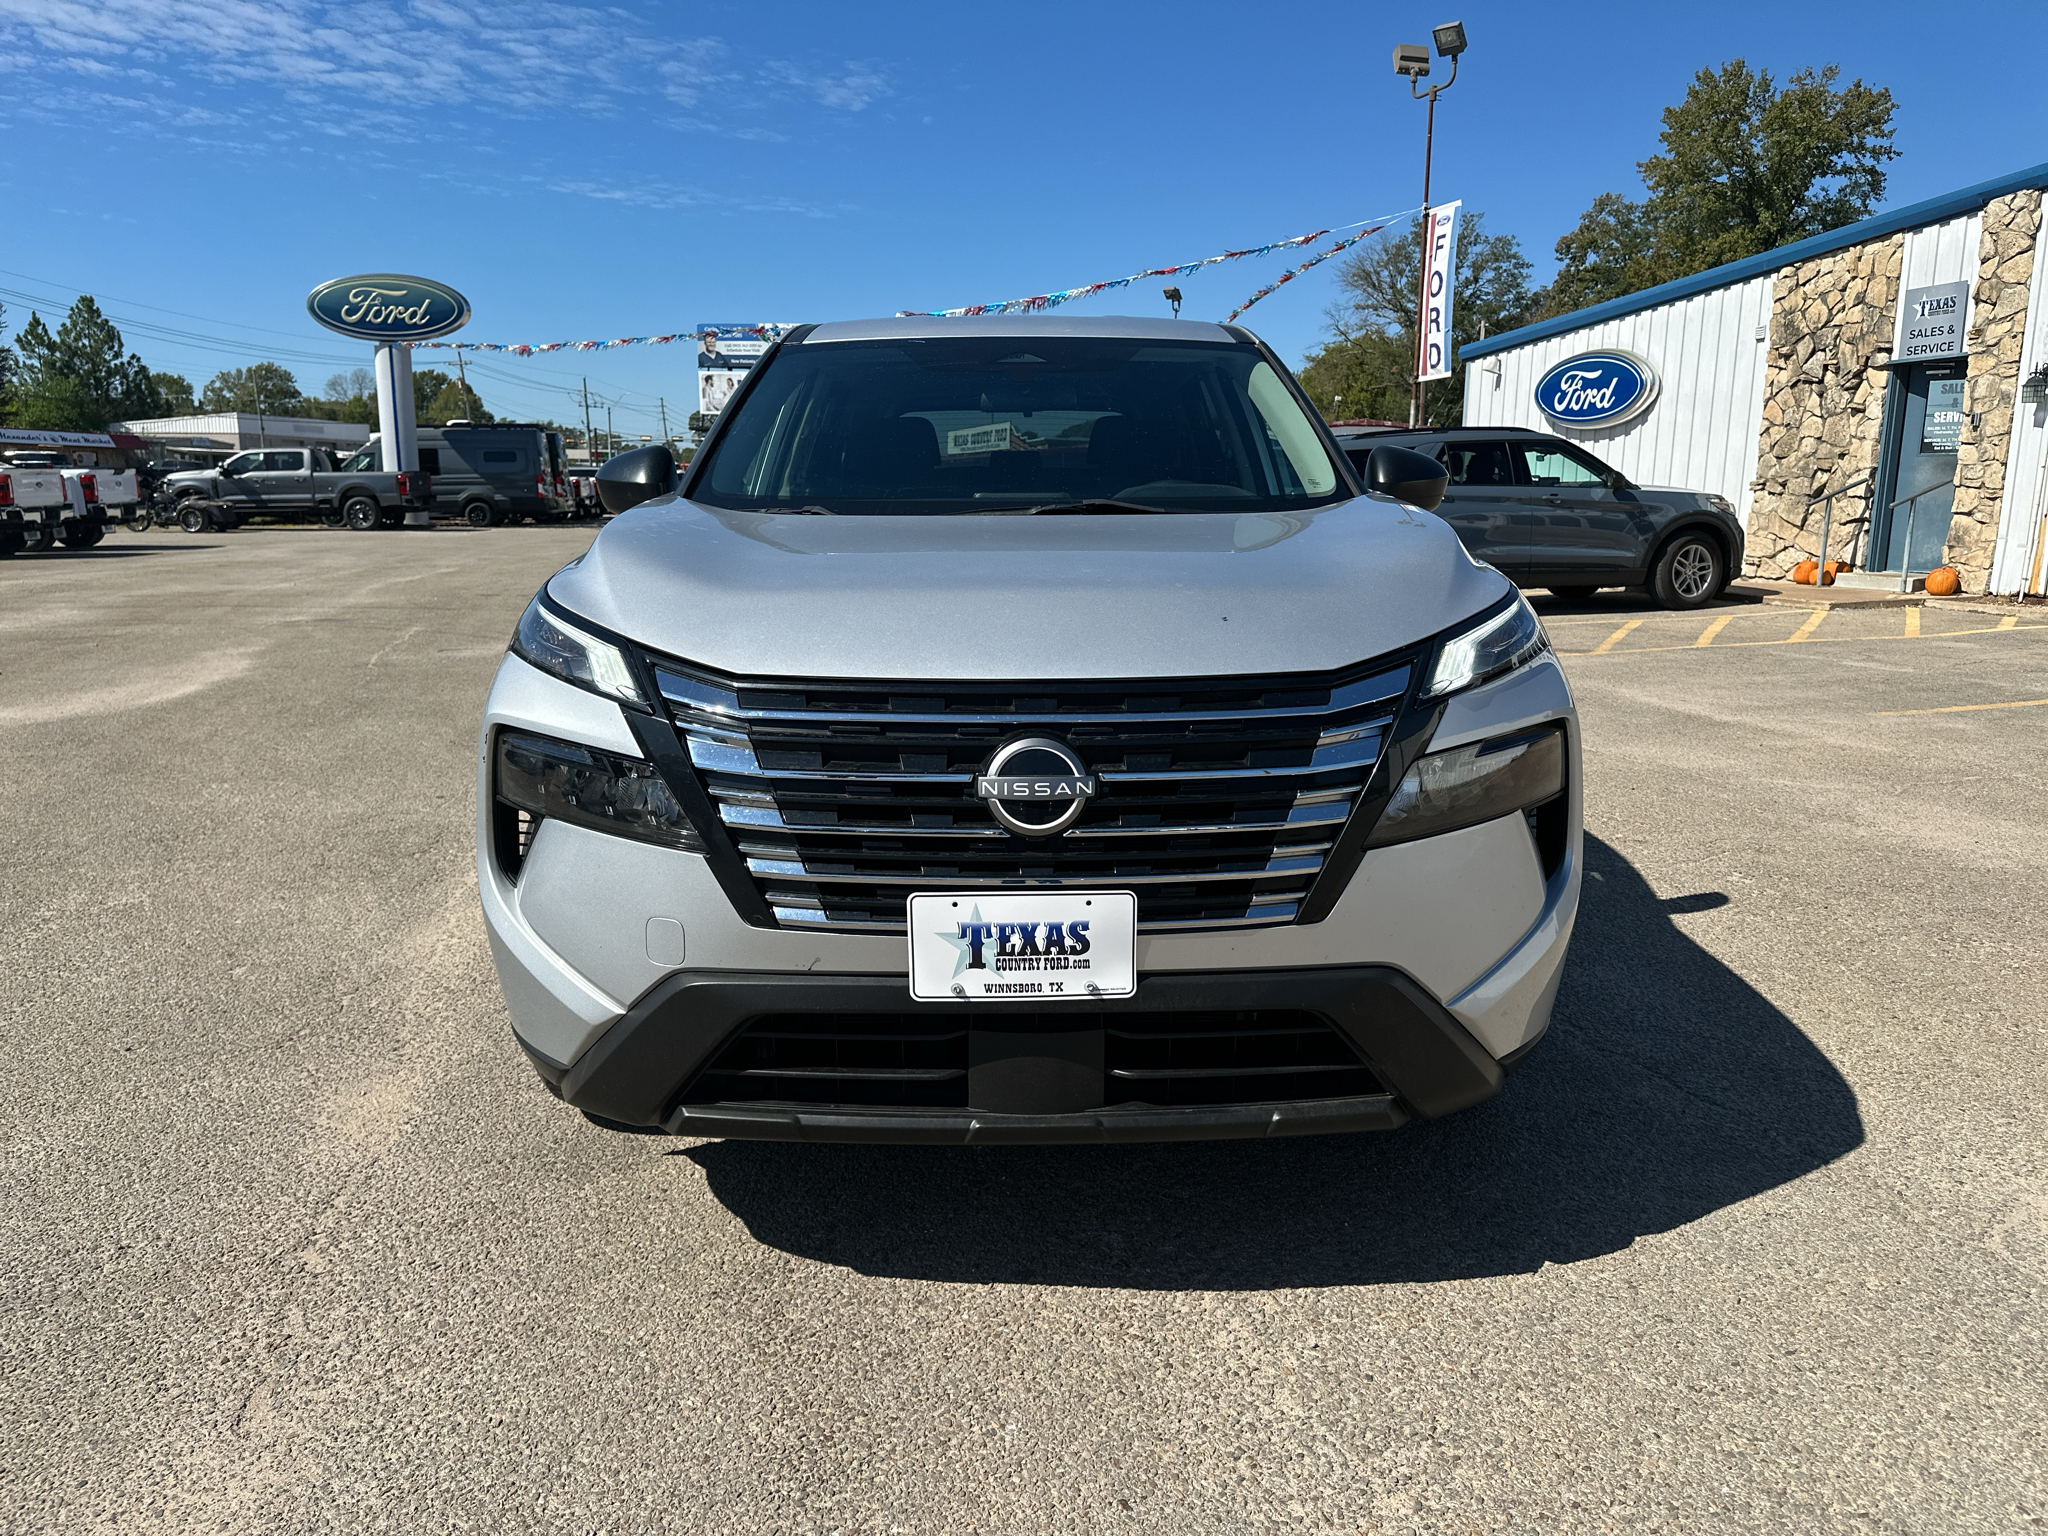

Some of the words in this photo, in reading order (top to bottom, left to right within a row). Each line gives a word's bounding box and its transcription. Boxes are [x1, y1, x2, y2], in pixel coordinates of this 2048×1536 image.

[341, 287, 431, 325] Ford
[1429, 233, 1447, 369] FORD
[1919, 295, 1957, 317] TEXAS
[1909, 325, 1944, 340] SALES
[1947, 324, 1955, 335] &
[1906, 341, 1955, 356] SERVICE
[1554, 369, 1618, 411] Ford
[1941, 383, 1965, 394] SALE
[1951, 398, 1959, 408] &
[1933, 411, 1965, 423] SERVI
[981, 781, 1092, 796] NISSAN
[957, 920, 1091, 970] TEXAS
[995, 957, 1041, 971] COUNTRY
[1043, 957, 1091, 971] FORD.com
[1048, 982, 1064, 992] TX
